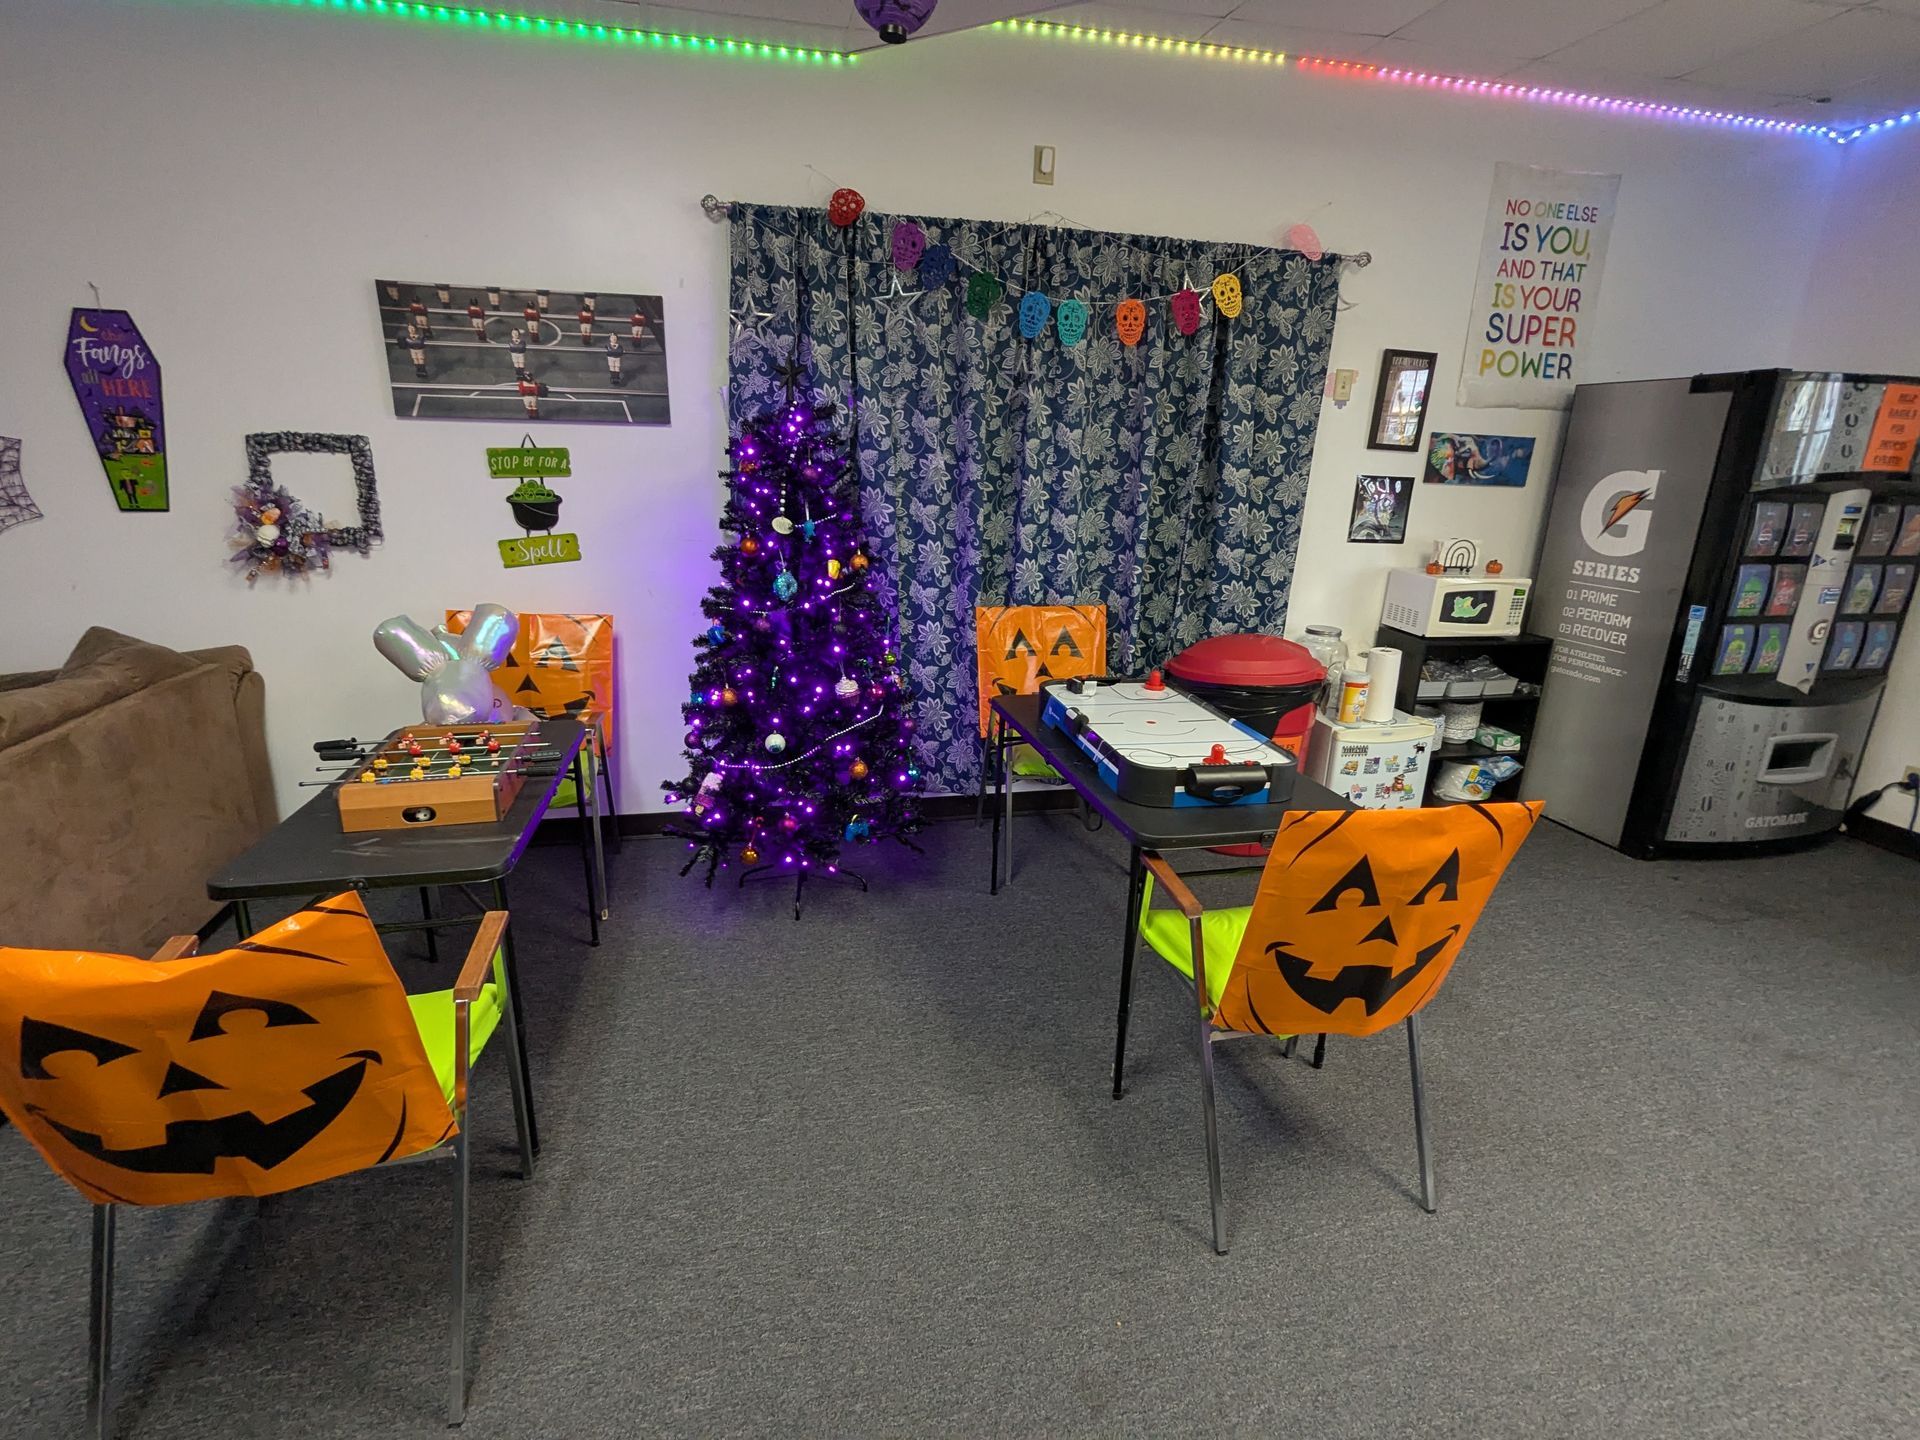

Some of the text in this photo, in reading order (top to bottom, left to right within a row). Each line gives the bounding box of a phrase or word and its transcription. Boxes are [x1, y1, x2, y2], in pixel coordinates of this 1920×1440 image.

[1506, 199, 1598, 224] NO ONE ELSE
[1500, 222, 1591, 260] IS YOU,
[1496, 258, 1587, 283] AND THAT
[1491, 283, 1581, 313] IS YOUR
[1486, 312, 1576, 348] SUPER
[72, 336, 146, 379] Fangs
[1479, 348, 1572, 379] POWER
[101, 378, 152, 398] HERE
[490, 455, 567, 471] STOP BY FOR A
[1580, 469, 1661, 557] G
[517, 538, 567, 564] Spell
[1572, 559, 1641, 584] SERIES
[1566, 589, 1619, 607] 01 PRIME
[1562, 606, 1632, 629] 02 PERFORM
[1559, 623, 1628, 646] 03 RECOVER
[1552, 653, 1568, 663] FOR
[1554, 645, 1569, 654] FOR
